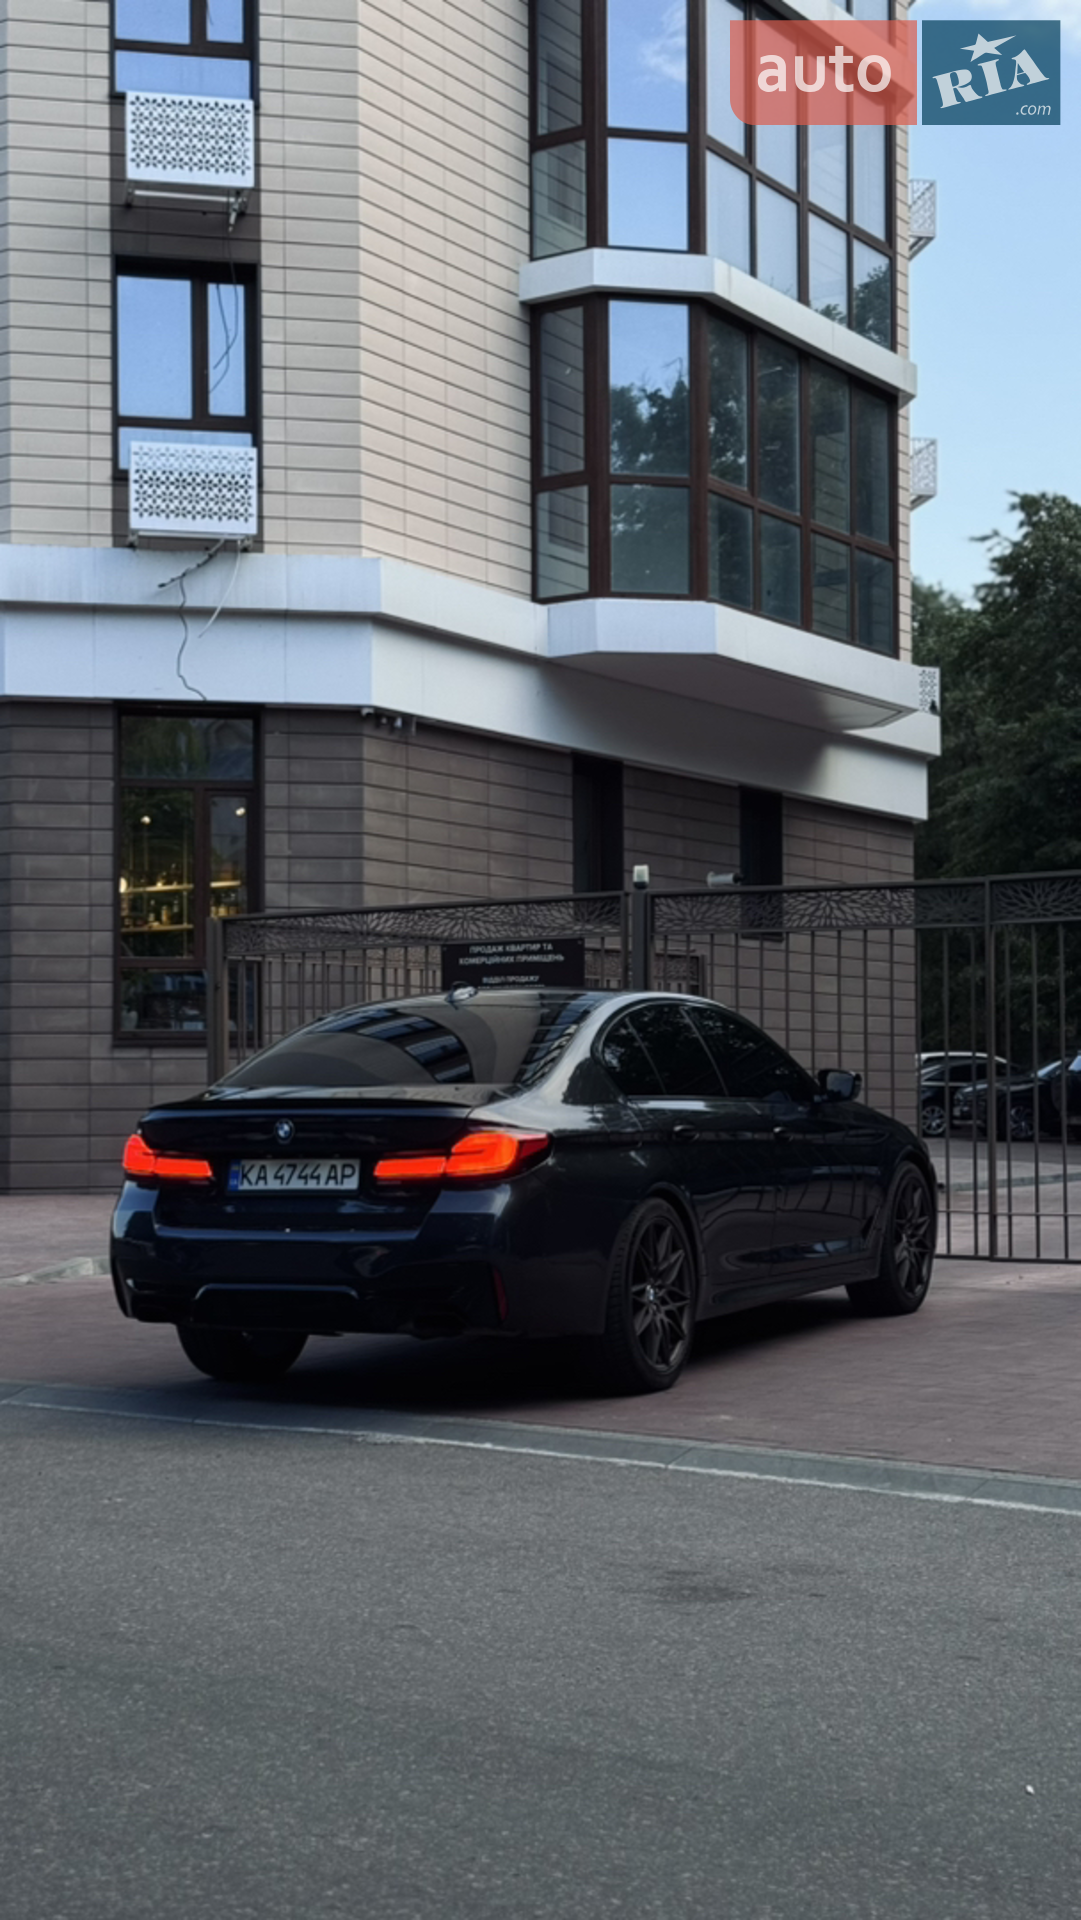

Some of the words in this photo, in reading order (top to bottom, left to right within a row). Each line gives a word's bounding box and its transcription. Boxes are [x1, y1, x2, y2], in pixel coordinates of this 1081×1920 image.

[469, 945, 504, 954] ПРОДАЖ
[506, 943, 541, 952] КВАРТИР
[542, 942, 553, 951] ТА
[459, 955, 515, 965] КОМЕРЦІЙНИХ
[516, 954, 564, 963] ПРИМІЩЕНЬ
[240, 1163, 268, 1186] KA
[273, 1163, 321, 1186] 4744
[324, 1163, 356, 1186] AP
